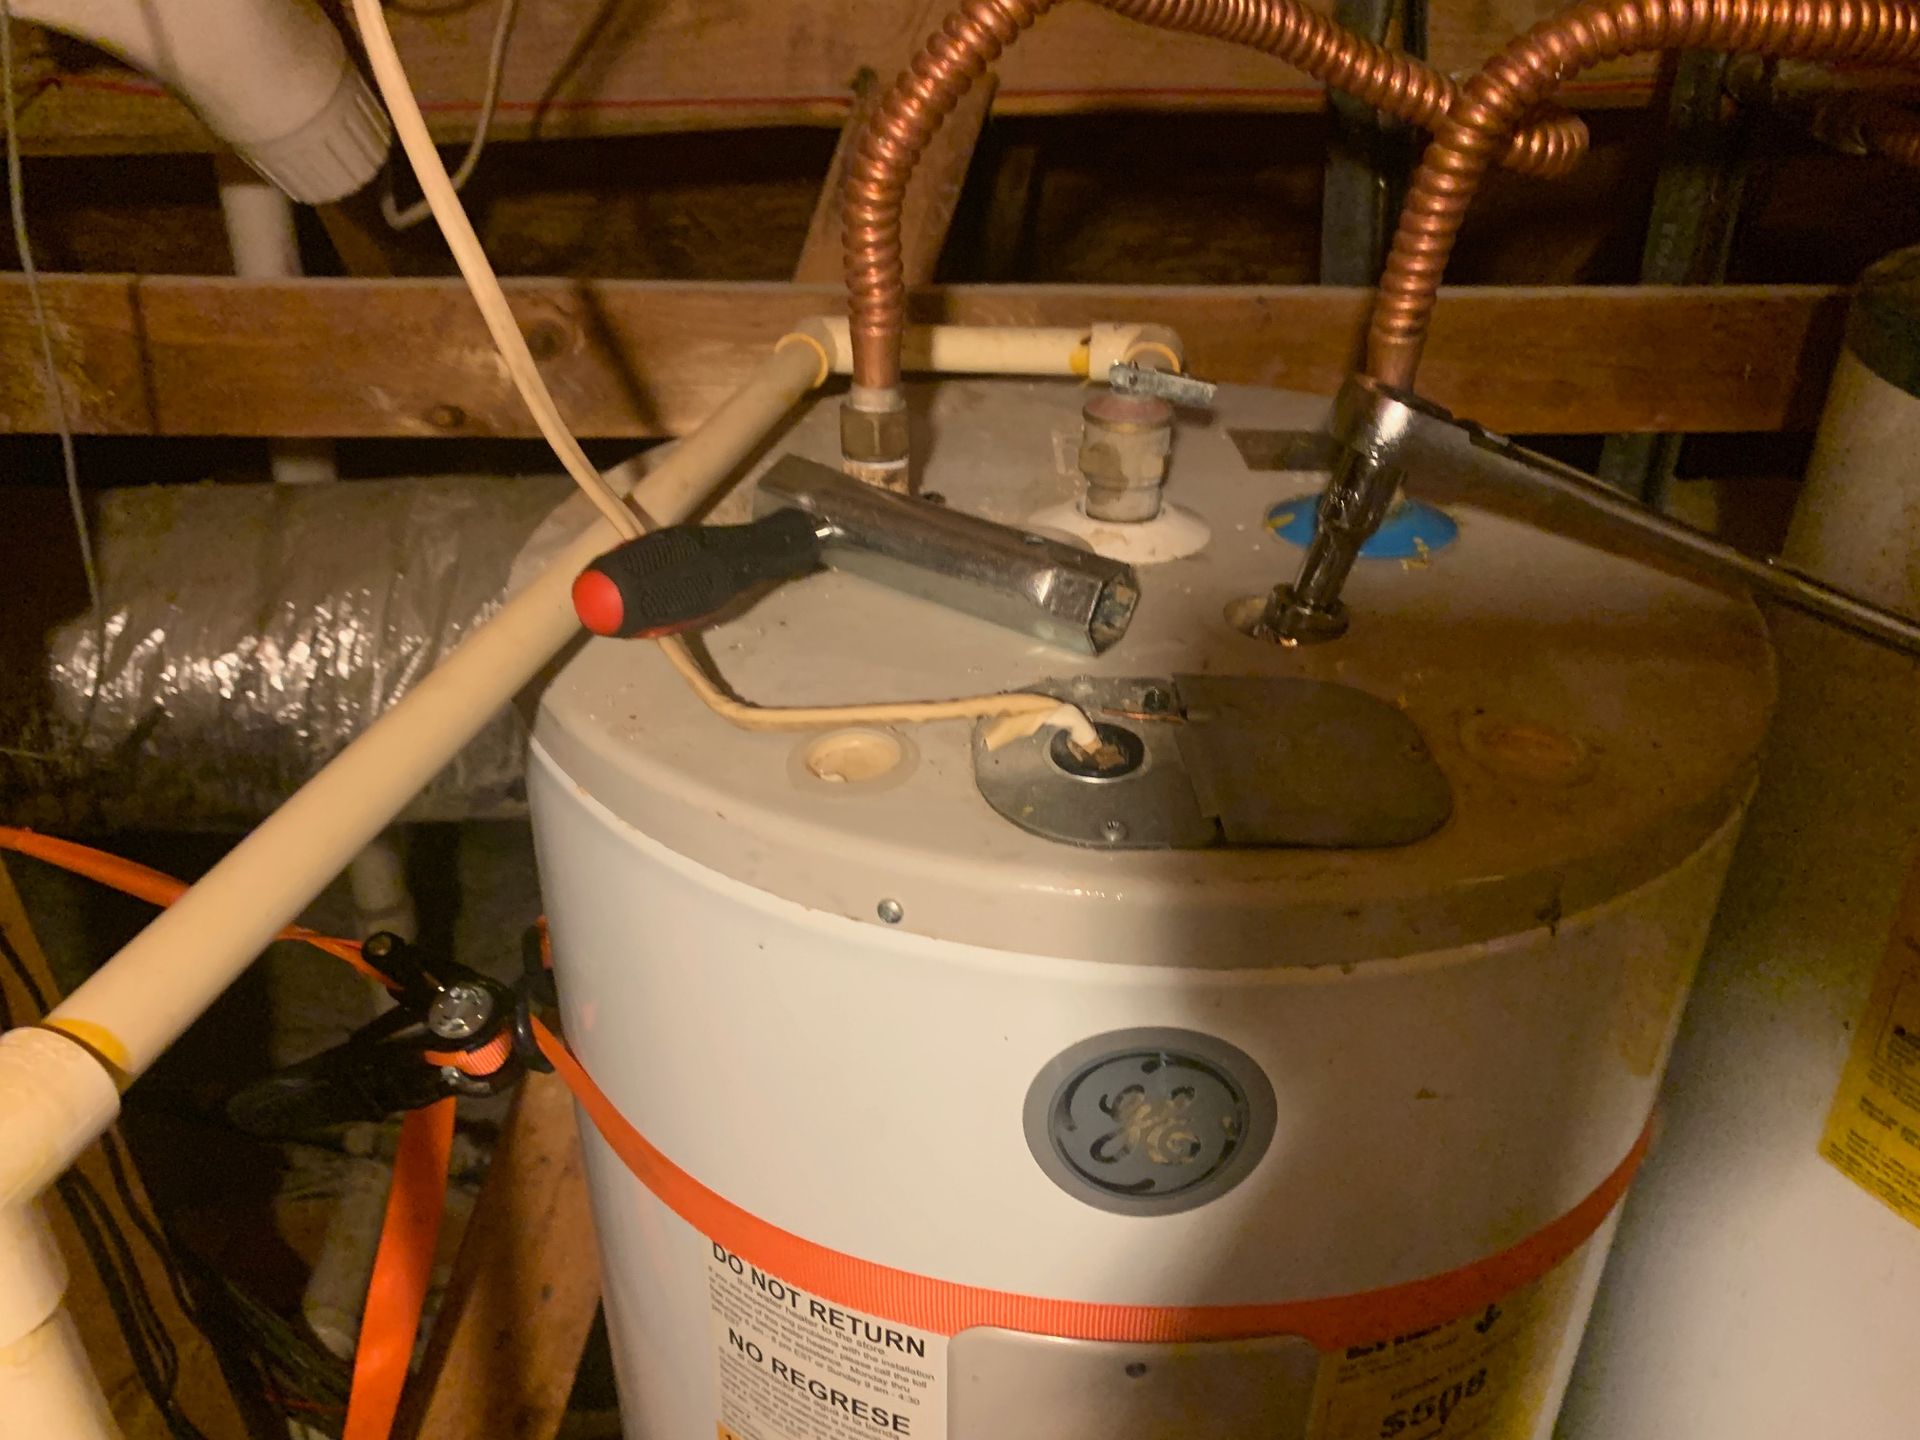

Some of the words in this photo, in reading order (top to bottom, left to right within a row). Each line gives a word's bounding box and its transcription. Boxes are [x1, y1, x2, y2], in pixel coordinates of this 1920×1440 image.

[712, 1241, 744, 1276] DO
[751, 1267, 801, 1308] NOT
[809, 1299, 925, 1358] RETURN
[821, 1324, 831, 1334] to
[834, 1330, 852, 1342] the
[729, 1328, 762, 1364] NO
[772, 1357, 910, 1436] REGRESE
